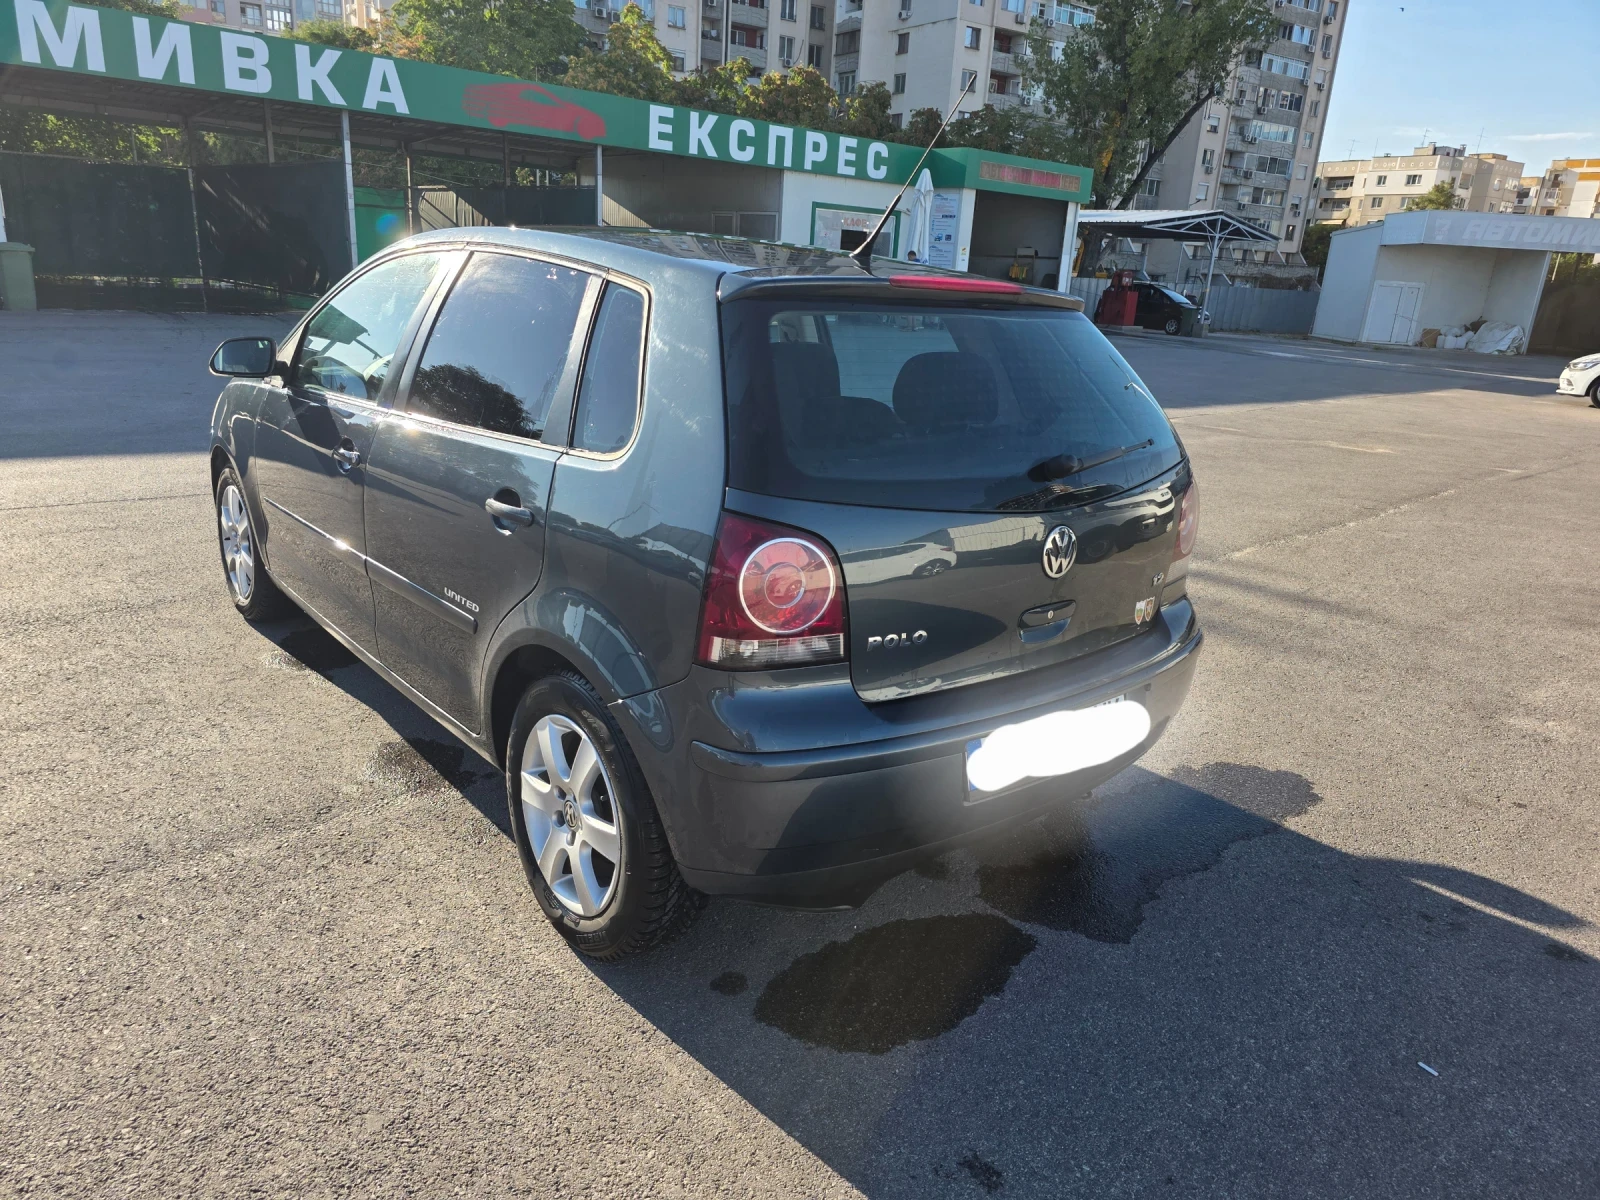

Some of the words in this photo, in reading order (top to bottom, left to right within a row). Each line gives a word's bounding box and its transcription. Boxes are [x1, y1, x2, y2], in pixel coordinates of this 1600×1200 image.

[16, 0, 410, 115] МИВКА
[648, 104, 889, 180] ЕКСПРЕС
[843, 217, 867, 228] КАФЕ
[444, 587, 479, 613] UNITED
[867, 629, 928, 652] POLO
